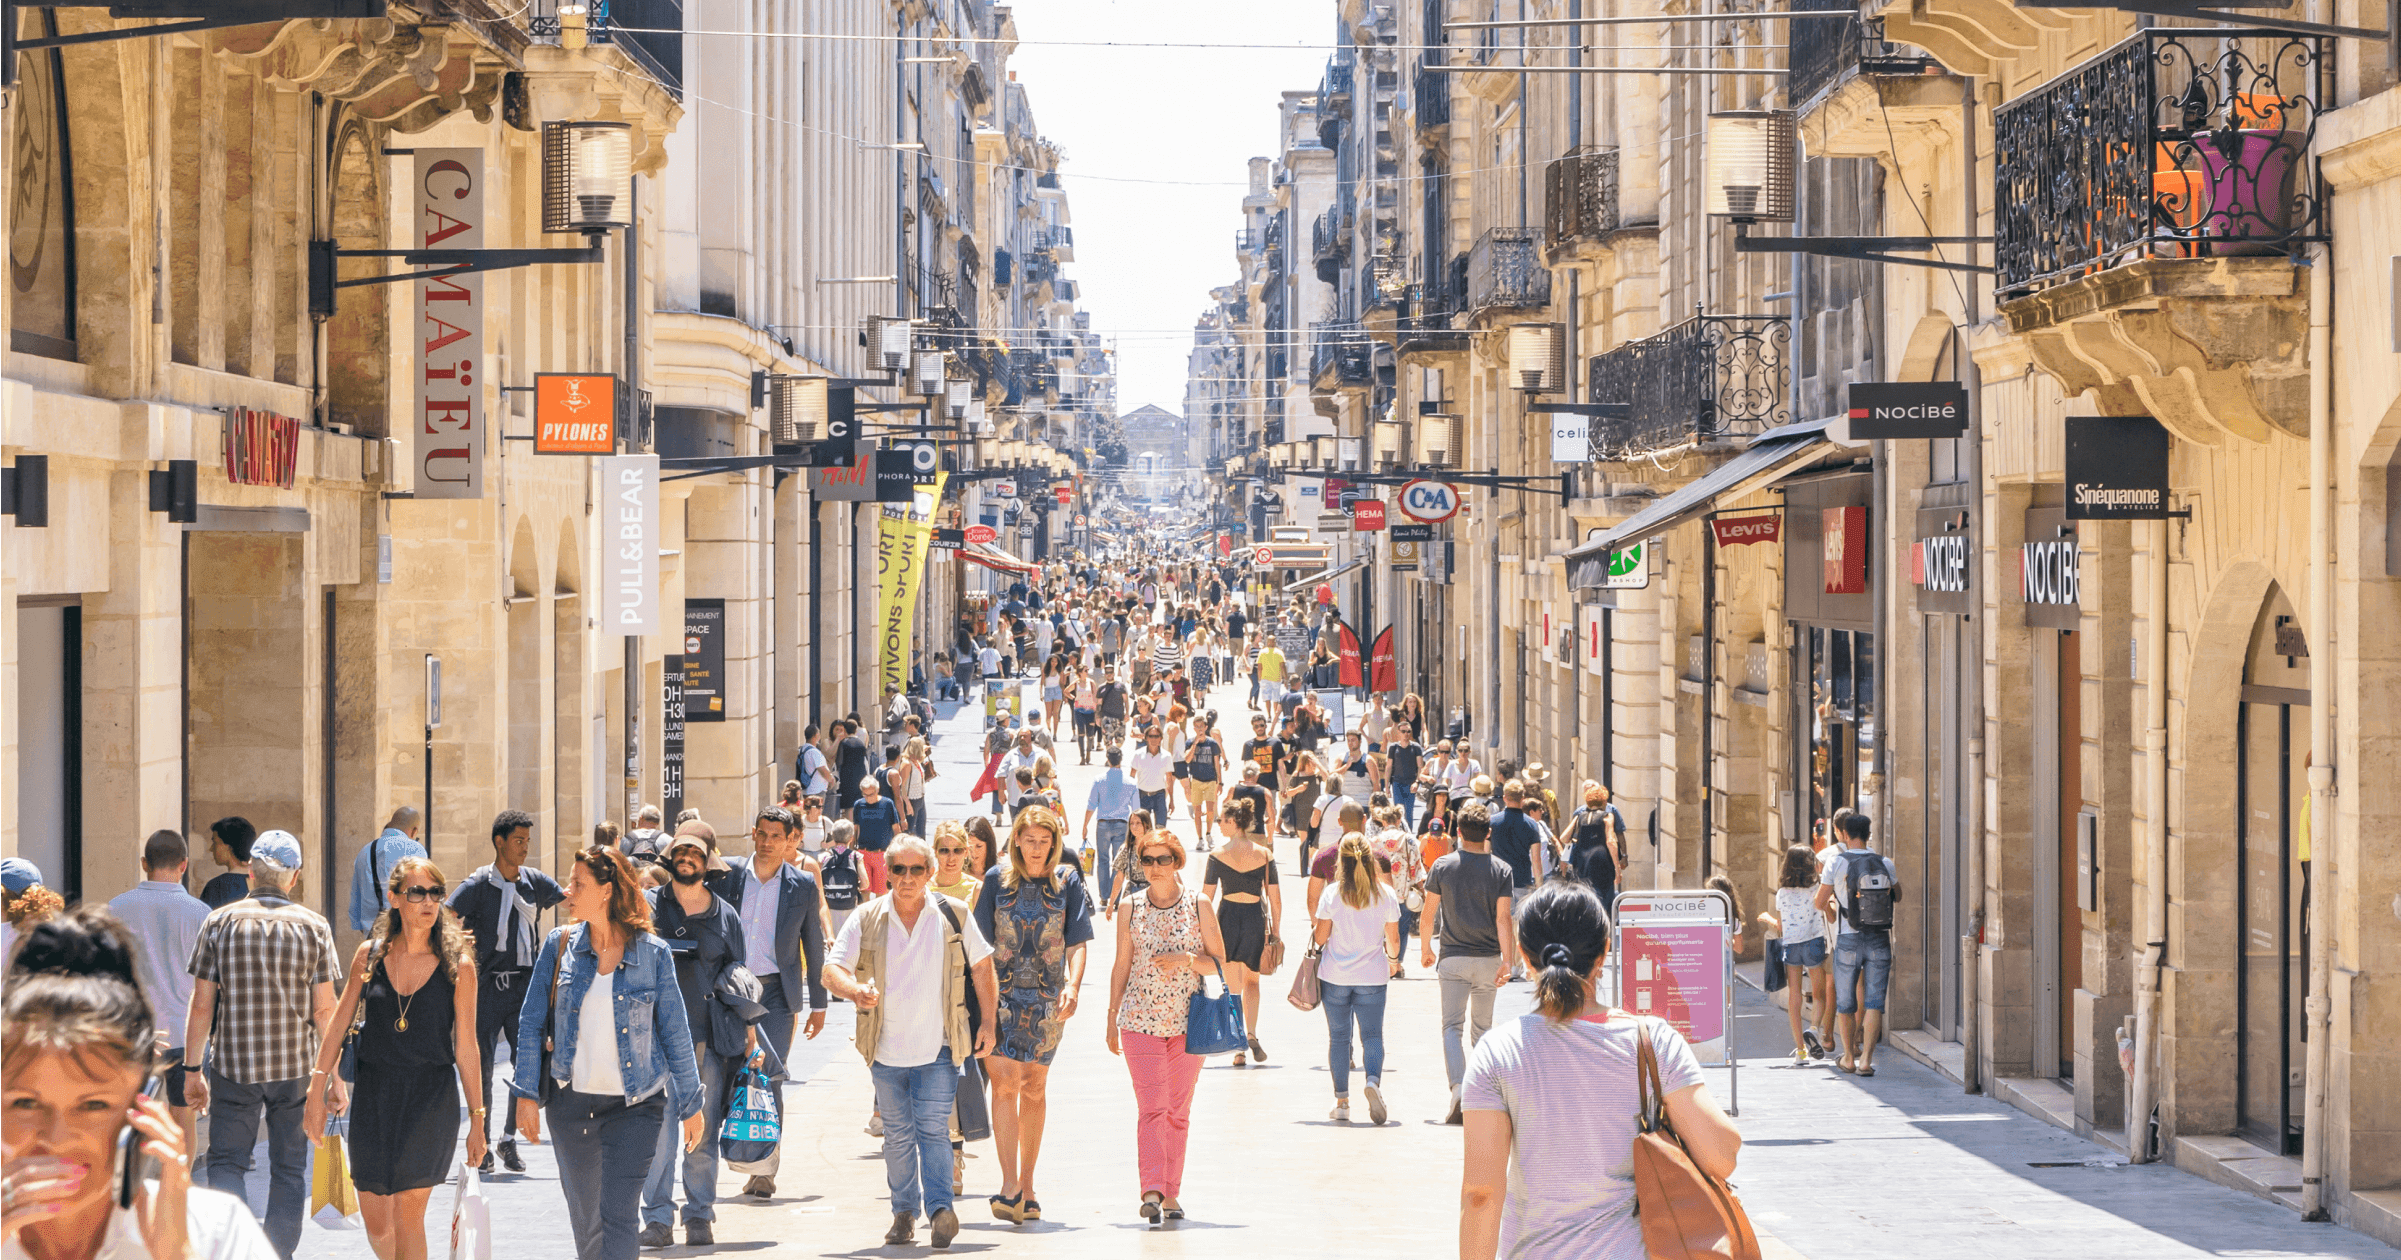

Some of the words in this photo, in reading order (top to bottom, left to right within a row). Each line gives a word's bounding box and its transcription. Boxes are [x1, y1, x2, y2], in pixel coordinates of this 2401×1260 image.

[543, 423, 608, 441] PYLONES
[1409, 487, 1450, 510] C&A
[2075, 483, 2159, 510] Sinéquanone
[1356, 510, 1383, 519] HEMA
[611, 468, 643, 624] PULL&BEAR
